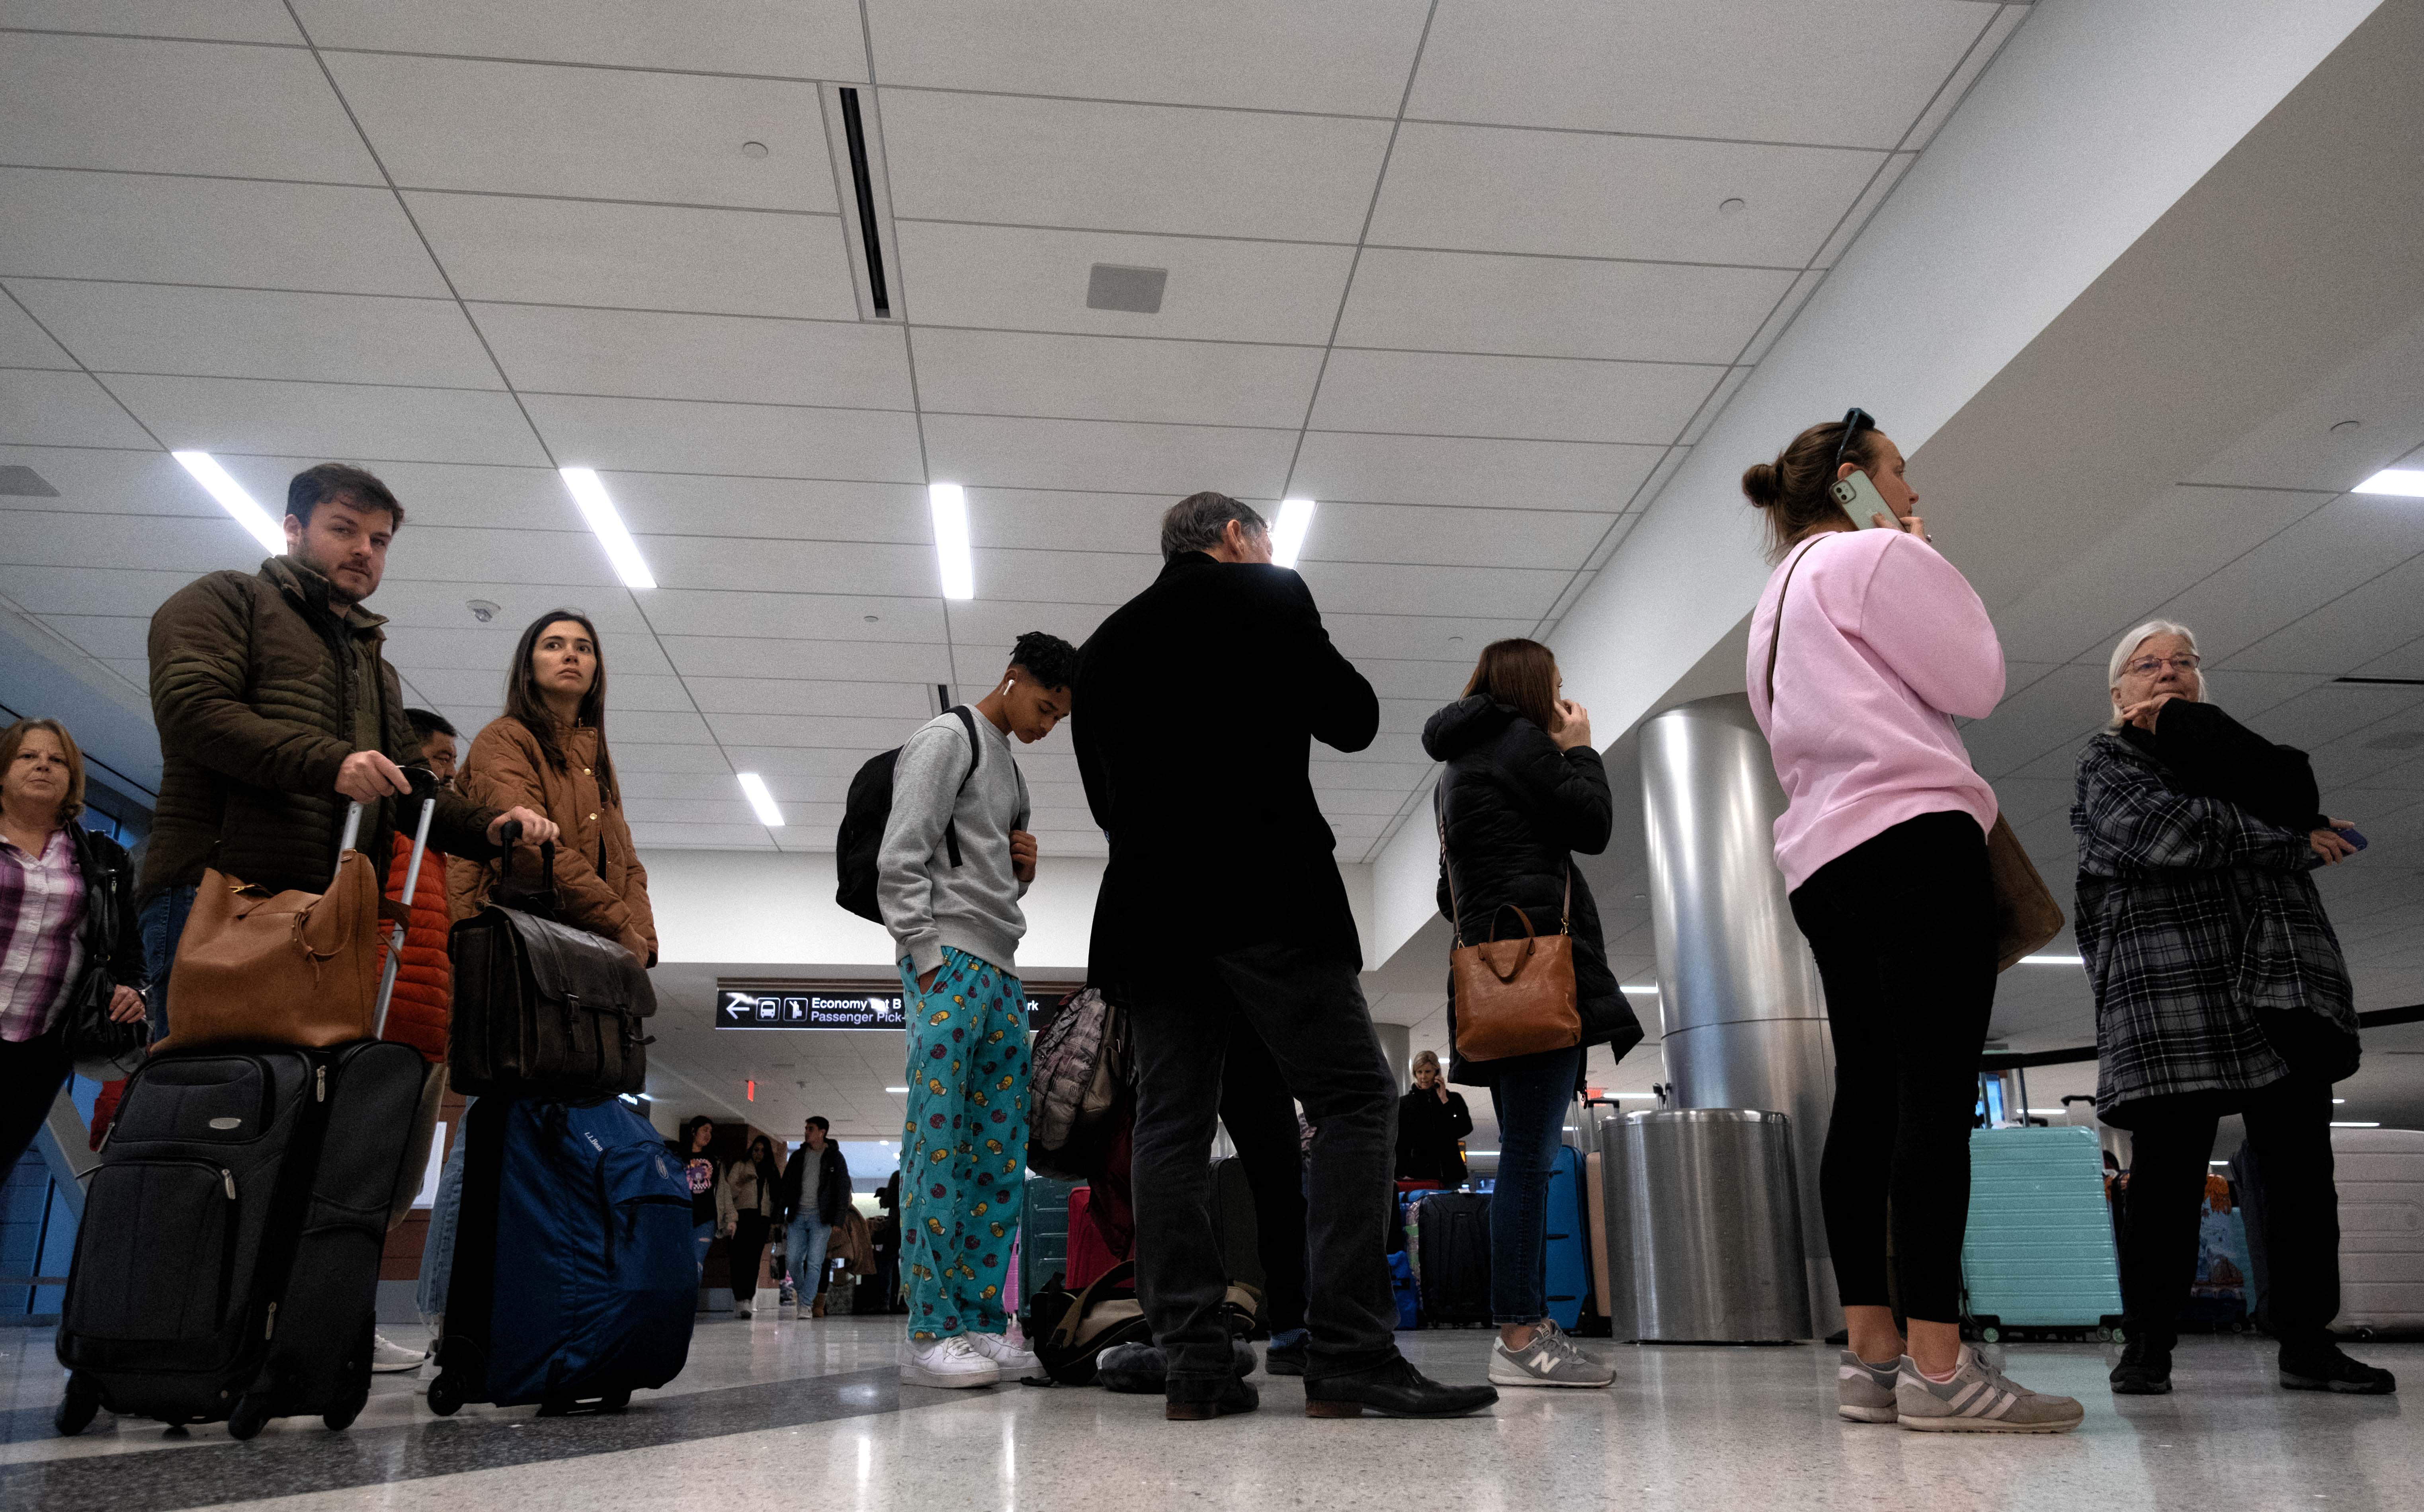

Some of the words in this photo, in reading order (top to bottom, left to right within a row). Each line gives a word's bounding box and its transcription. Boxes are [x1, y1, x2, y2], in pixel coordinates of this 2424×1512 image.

[812, 998, 867, 1011] Economy
[893, 999, 901, 1009] B
[811, 1011, 873, 1024] Passenger
[877, 1012, 906, 1022] Pick-
[1528, 1350, 1561, 1374] N
